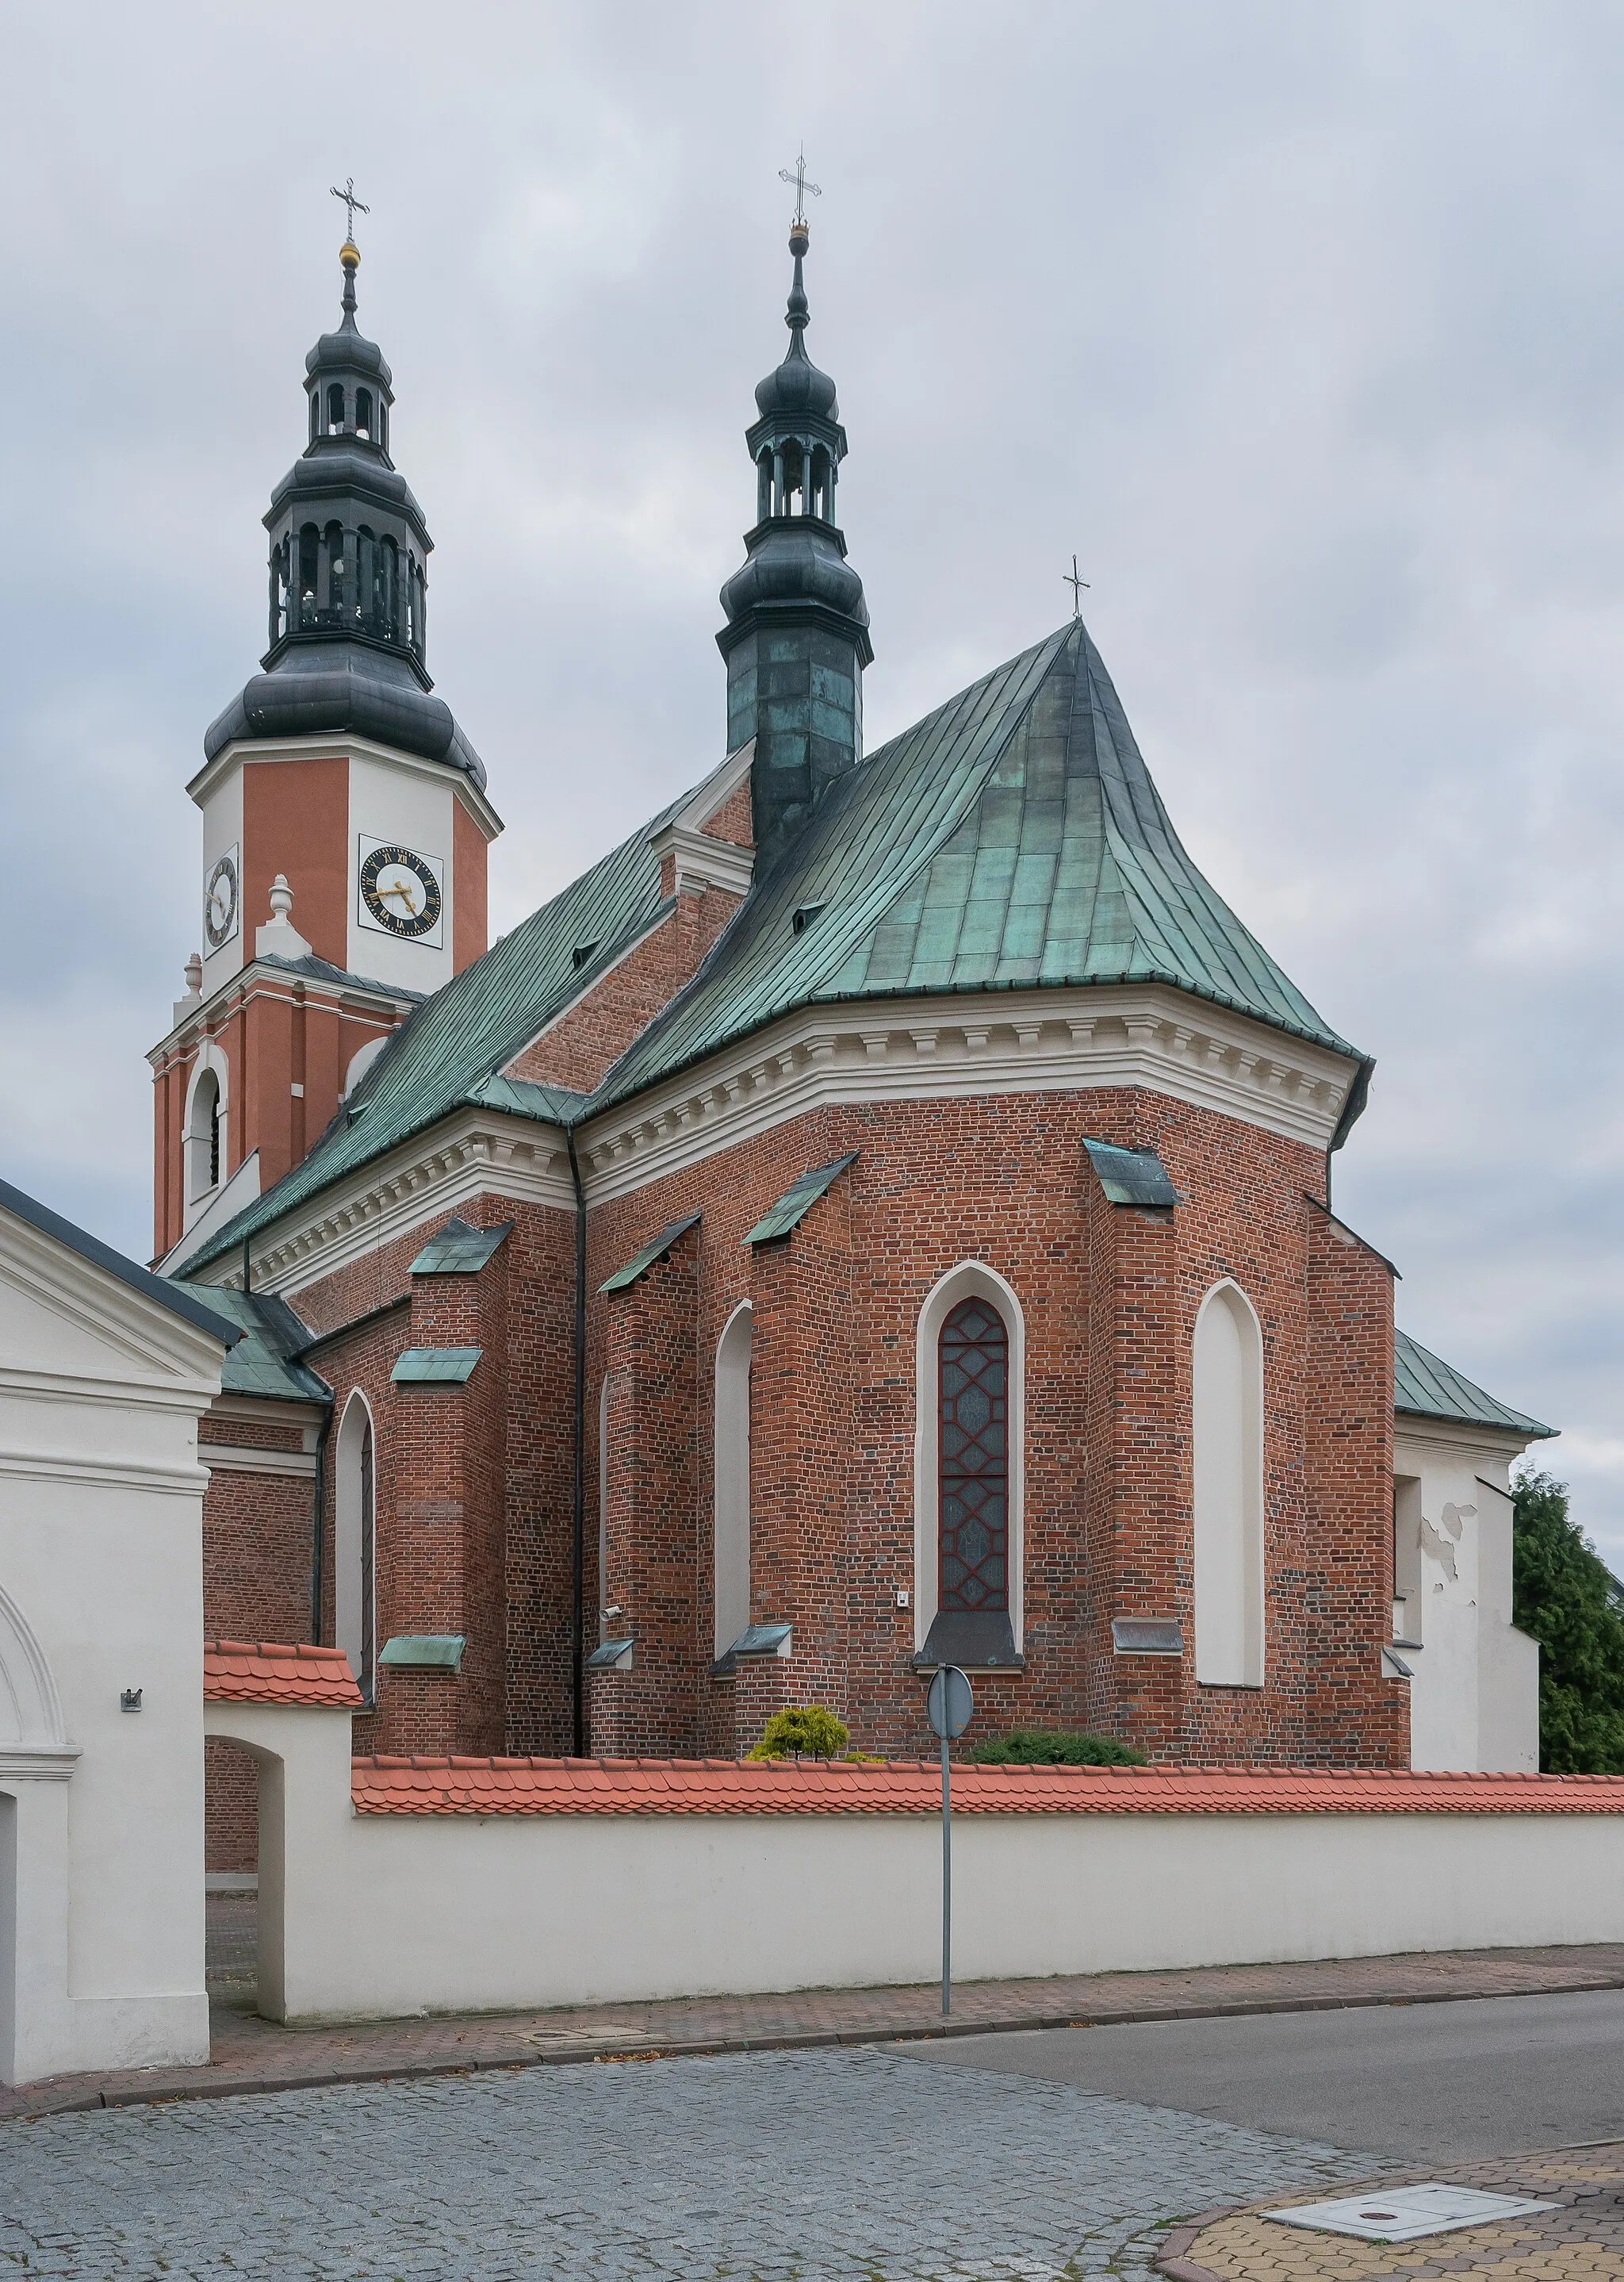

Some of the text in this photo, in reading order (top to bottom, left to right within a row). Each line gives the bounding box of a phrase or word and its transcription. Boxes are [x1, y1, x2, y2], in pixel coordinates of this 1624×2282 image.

[382, 853, 392, 864] XI
[397, 853, 408, 865] XII
[371, 861, 381, 872] X
[366, 876, 376, 888] IX
[427, 896, 436, 905] III
[380, 908, 390, 922] VII
[421, 909, 433, 922] IIII
[396, 919, 404, 929] VI
[414, 920, 420, 929] V
